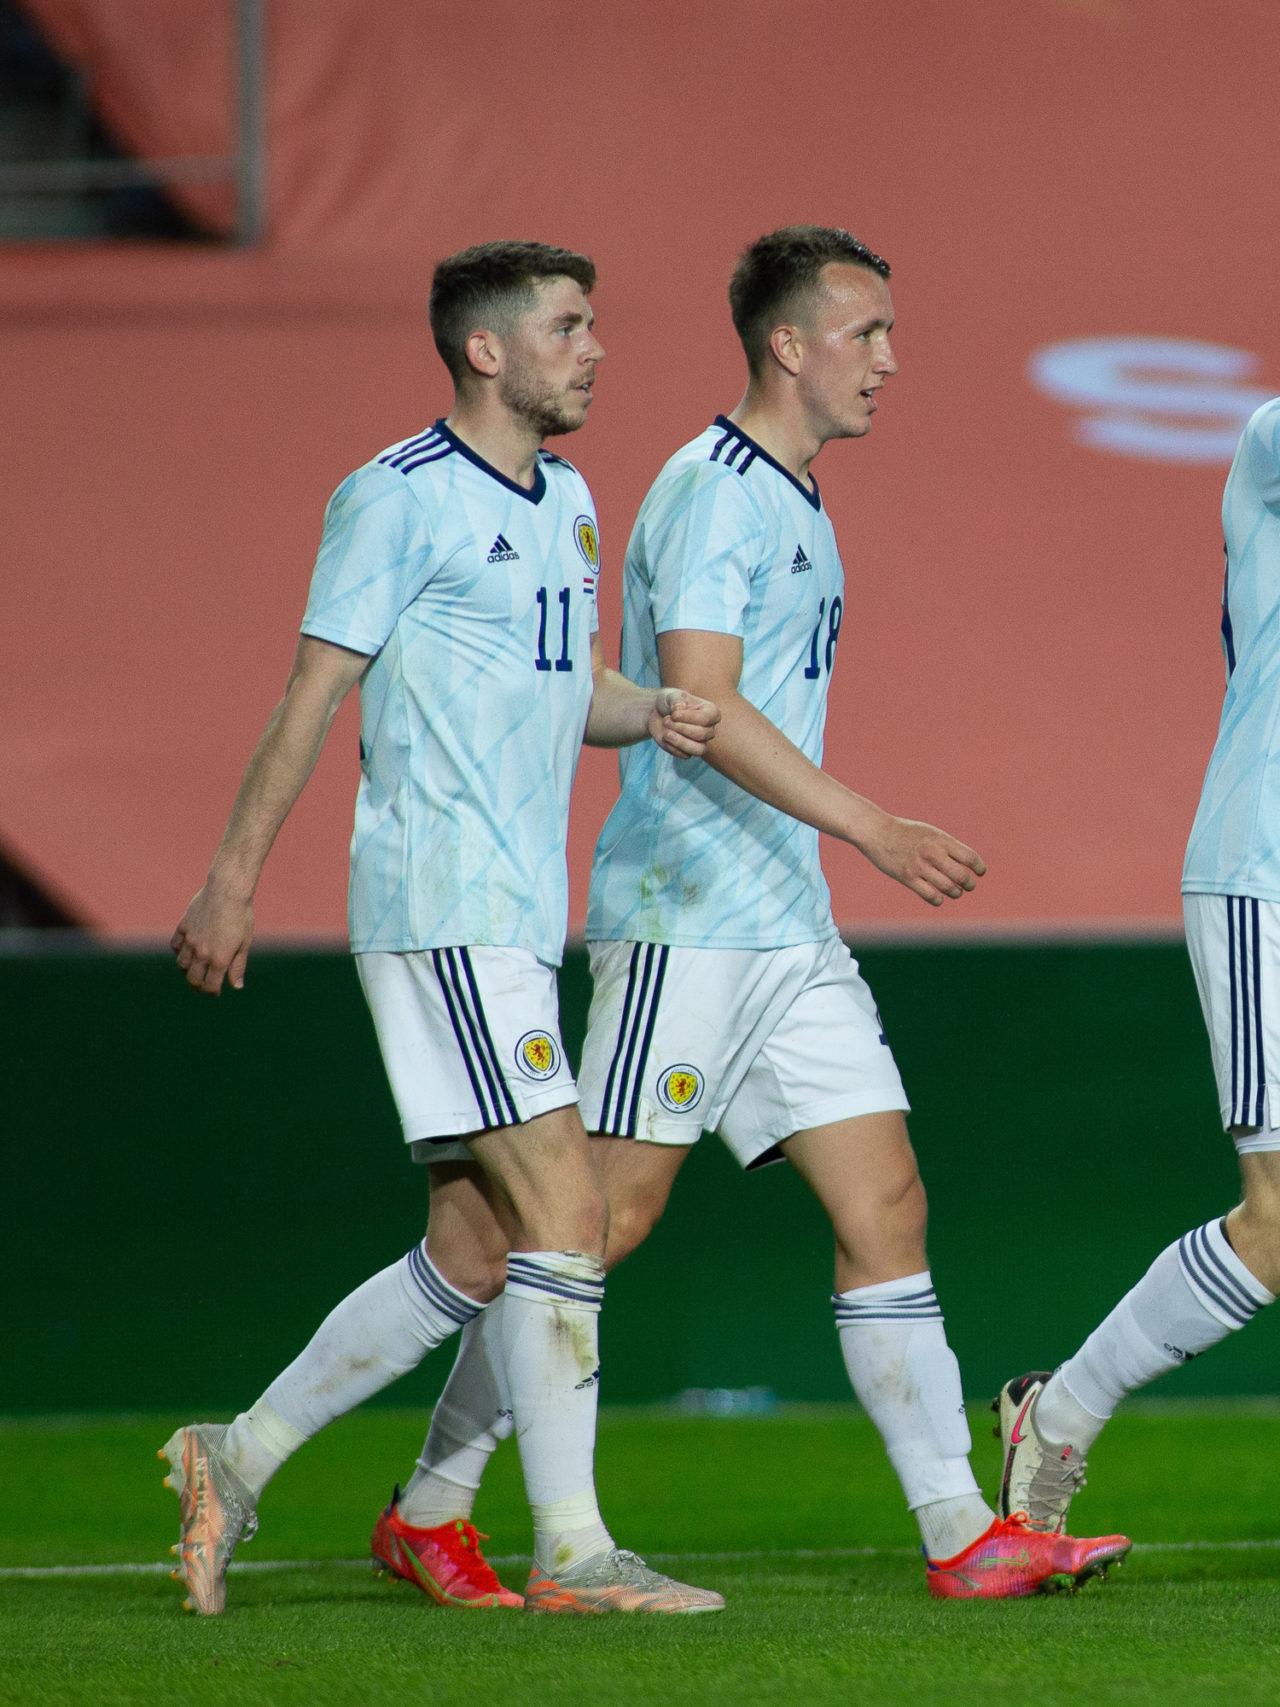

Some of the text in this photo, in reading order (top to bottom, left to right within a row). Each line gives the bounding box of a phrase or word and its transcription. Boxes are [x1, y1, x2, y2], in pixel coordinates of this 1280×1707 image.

[487, 551, 520, 564] adidas
[535, 586, 573, 672] 11
[804, 595, 842, 679] 18
